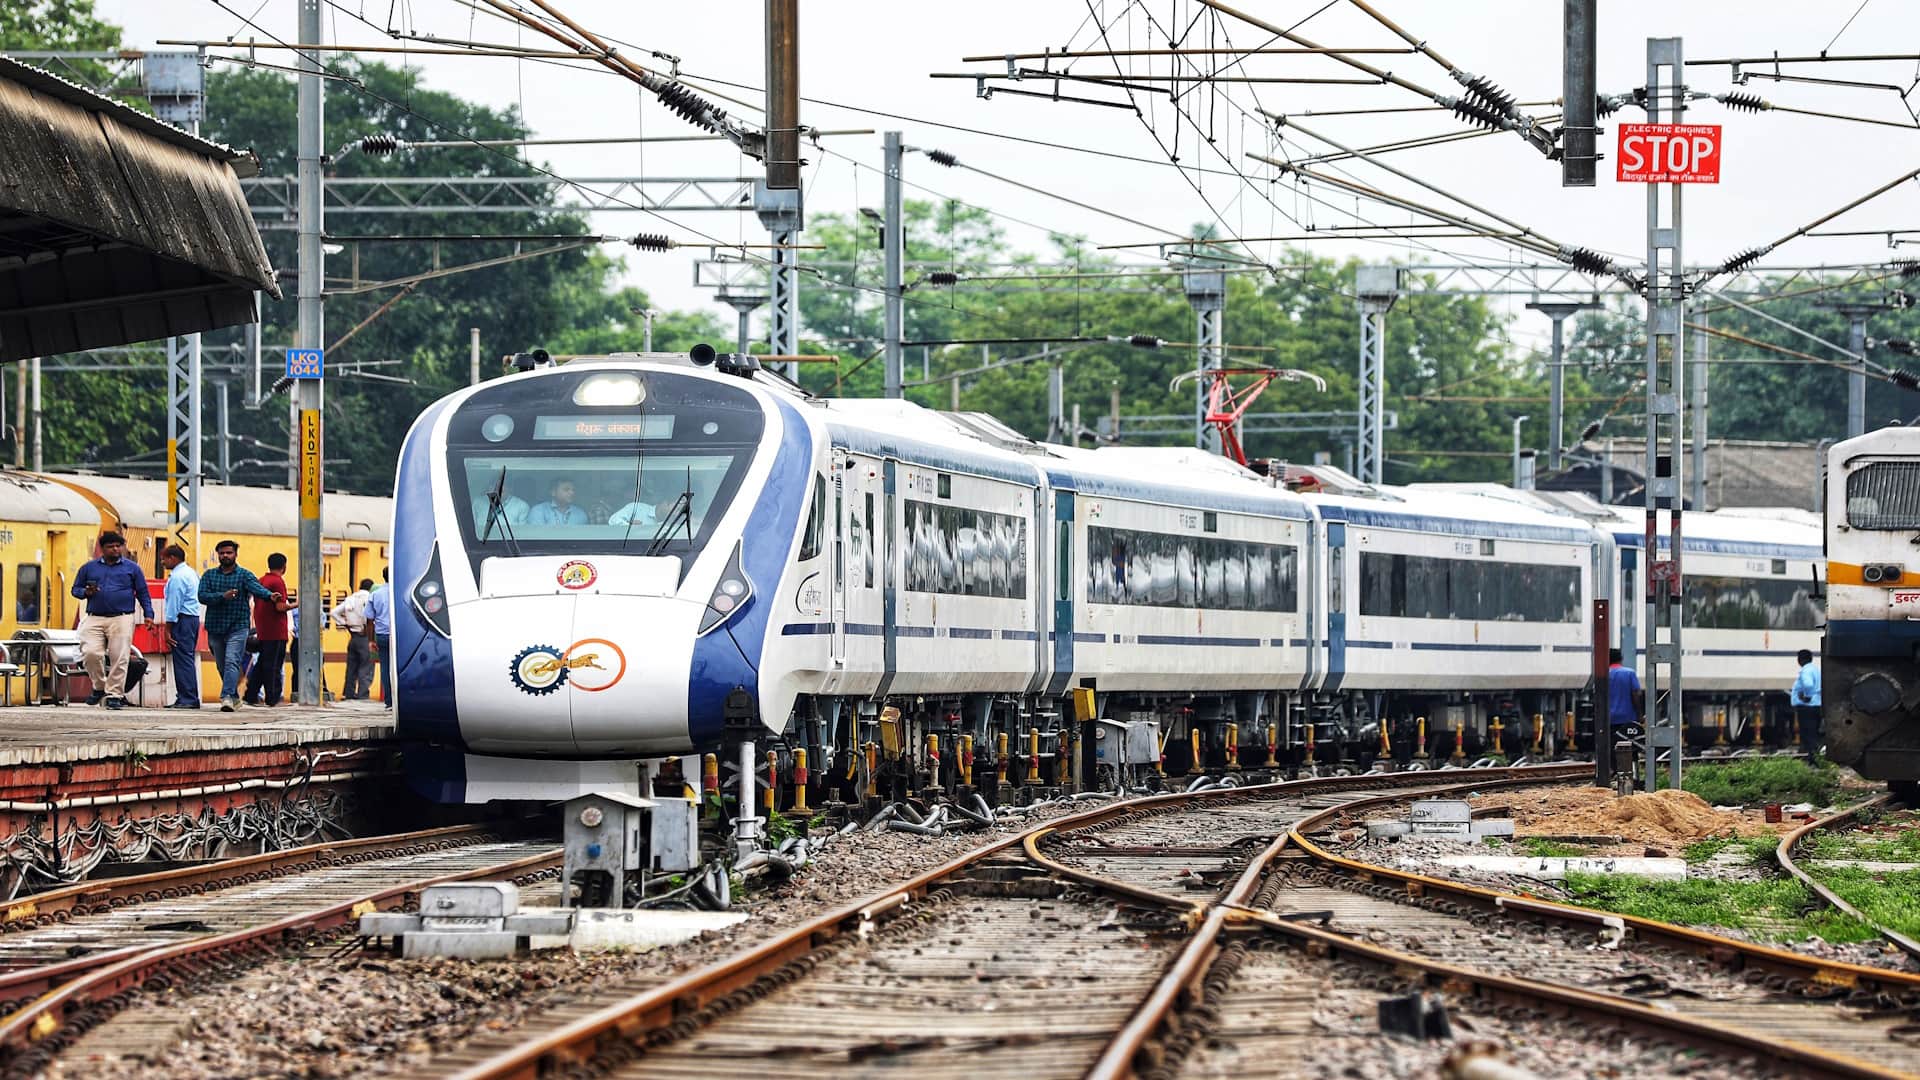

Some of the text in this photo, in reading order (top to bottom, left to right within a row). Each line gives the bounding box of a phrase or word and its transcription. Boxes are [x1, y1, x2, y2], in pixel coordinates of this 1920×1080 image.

[1627, 125, 1714, 134] ELECTRIC ENGINES
[1622, 135, 1714, 173] STOP
[291, 352, 319, 365] LKO
[290, 364, 320, 376] 1044
[307, 415, 315, 451] LKO
